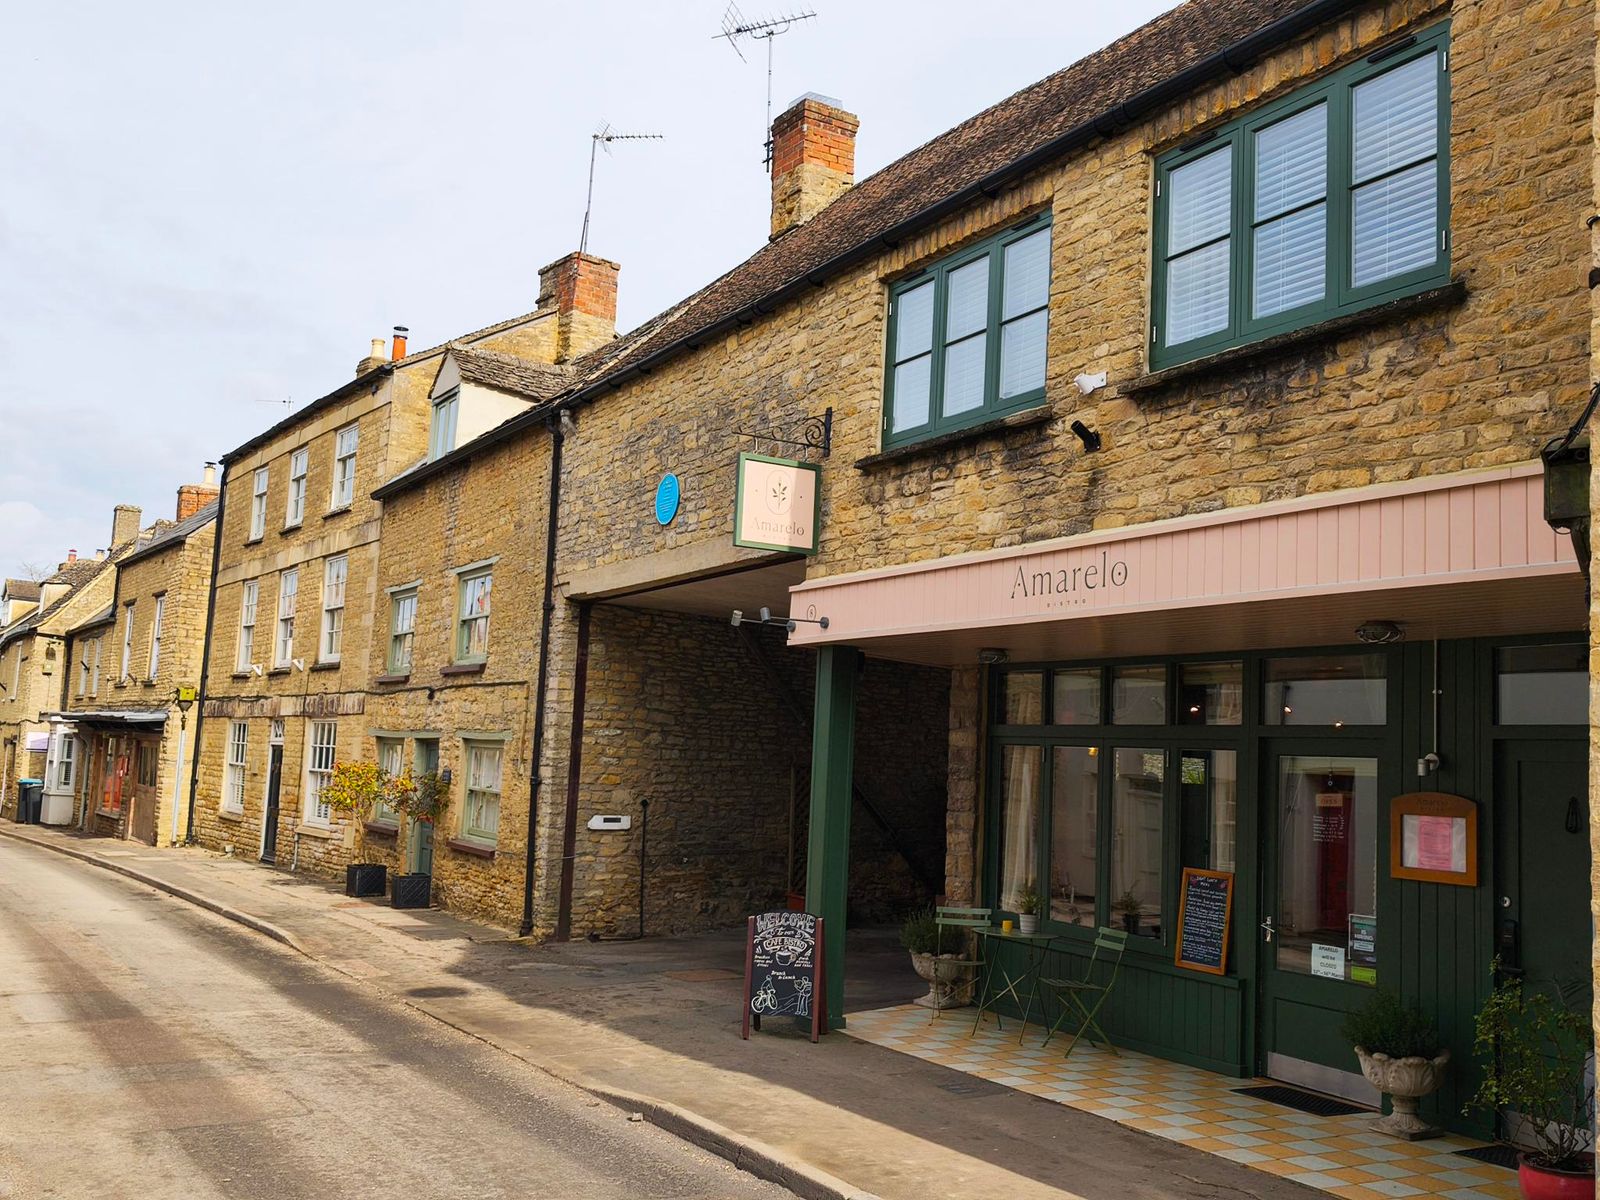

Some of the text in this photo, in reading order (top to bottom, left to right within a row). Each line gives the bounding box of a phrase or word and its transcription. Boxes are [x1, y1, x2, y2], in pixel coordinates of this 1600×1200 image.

[751, 516, 805, 537] Amarelo
[1010, 550, 1128, 599] Amarelo
[756, 912, 816, 934] WELCOME
